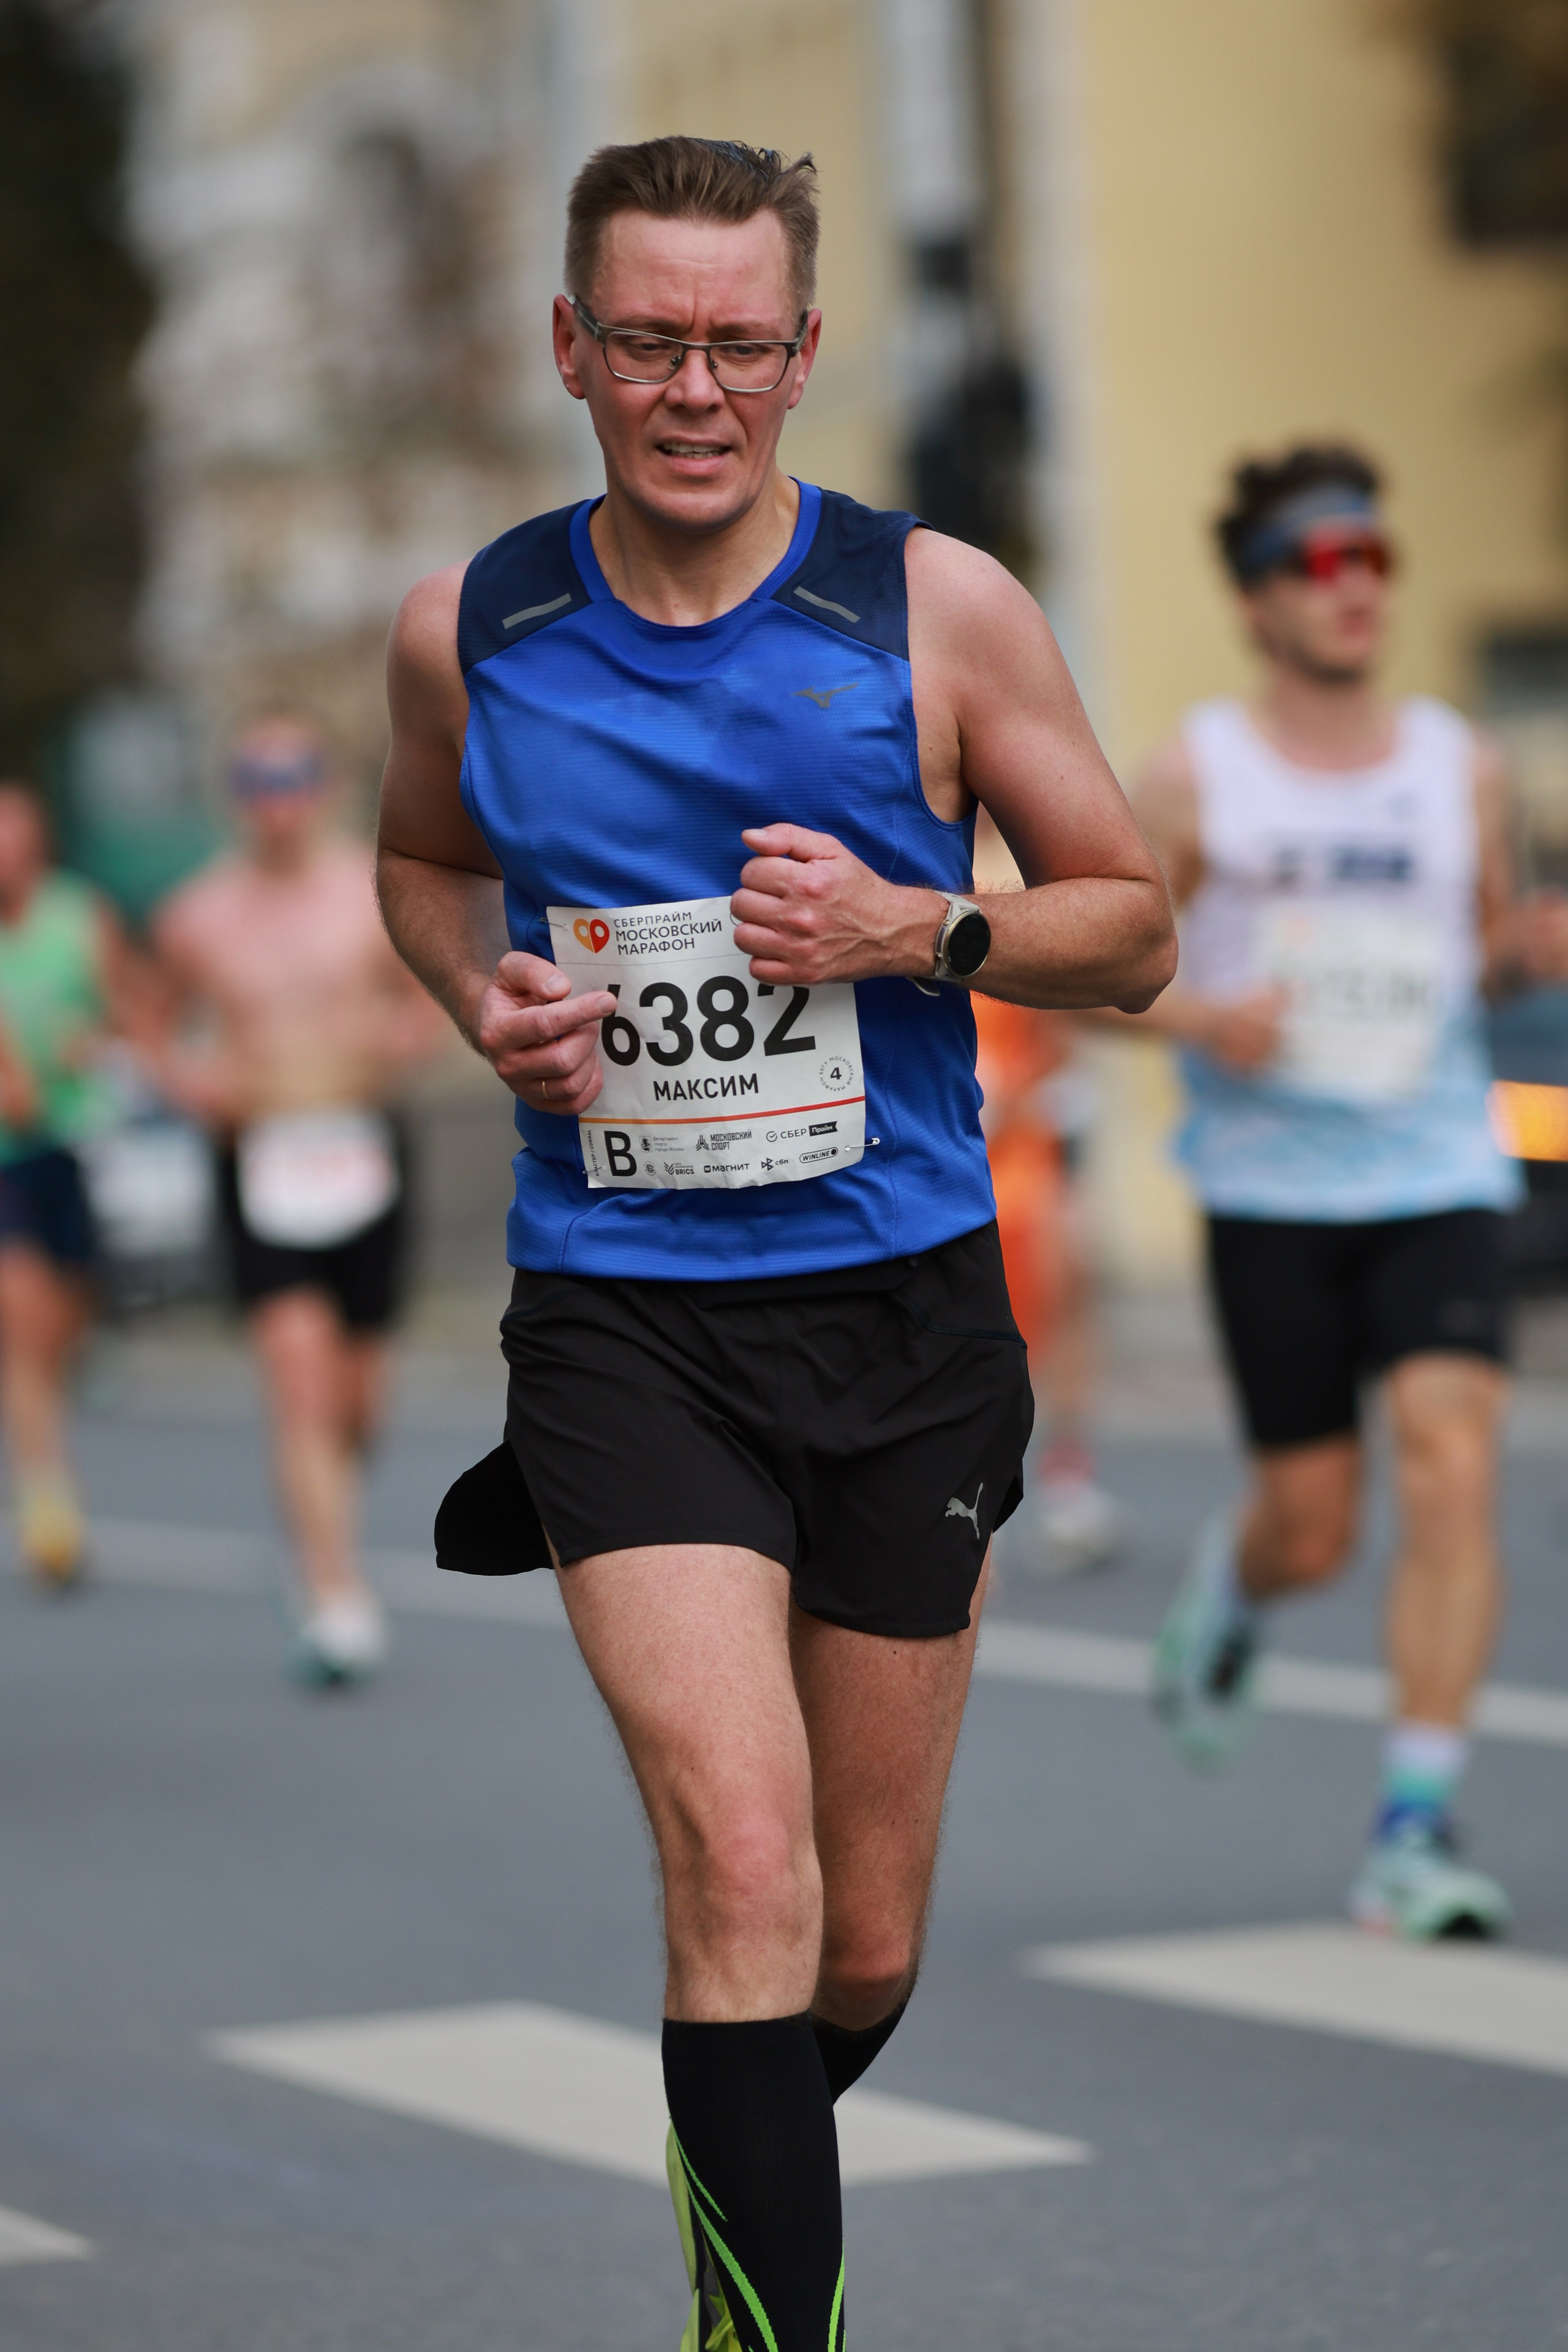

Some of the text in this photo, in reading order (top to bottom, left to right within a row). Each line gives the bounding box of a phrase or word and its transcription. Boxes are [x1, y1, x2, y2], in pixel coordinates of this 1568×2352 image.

[614, 911, 692, 927] СБЕРПРАЙМ
[616, 918, 722, 941] МОСКОВСКИЙ
[617, 938, 695, 955] МАРАФОН
[601, 975, 816, 1066] 6382
[830, 1066, 842, 1080] 4
[653, 1073, 759, 1101] МАКСИМ
[710, 1129, 752, 1142] МОСКОВСКИЙ
[780, 1128, 807, 1139] СБЕР
[711, 1142, 730, 1150] СПОРТ
[802, 1150, 830, 1161] WINLINE
[590, 1153, 599, 1177] КЛАСТЕР
[712, 1163, 750, 1172] магнит
